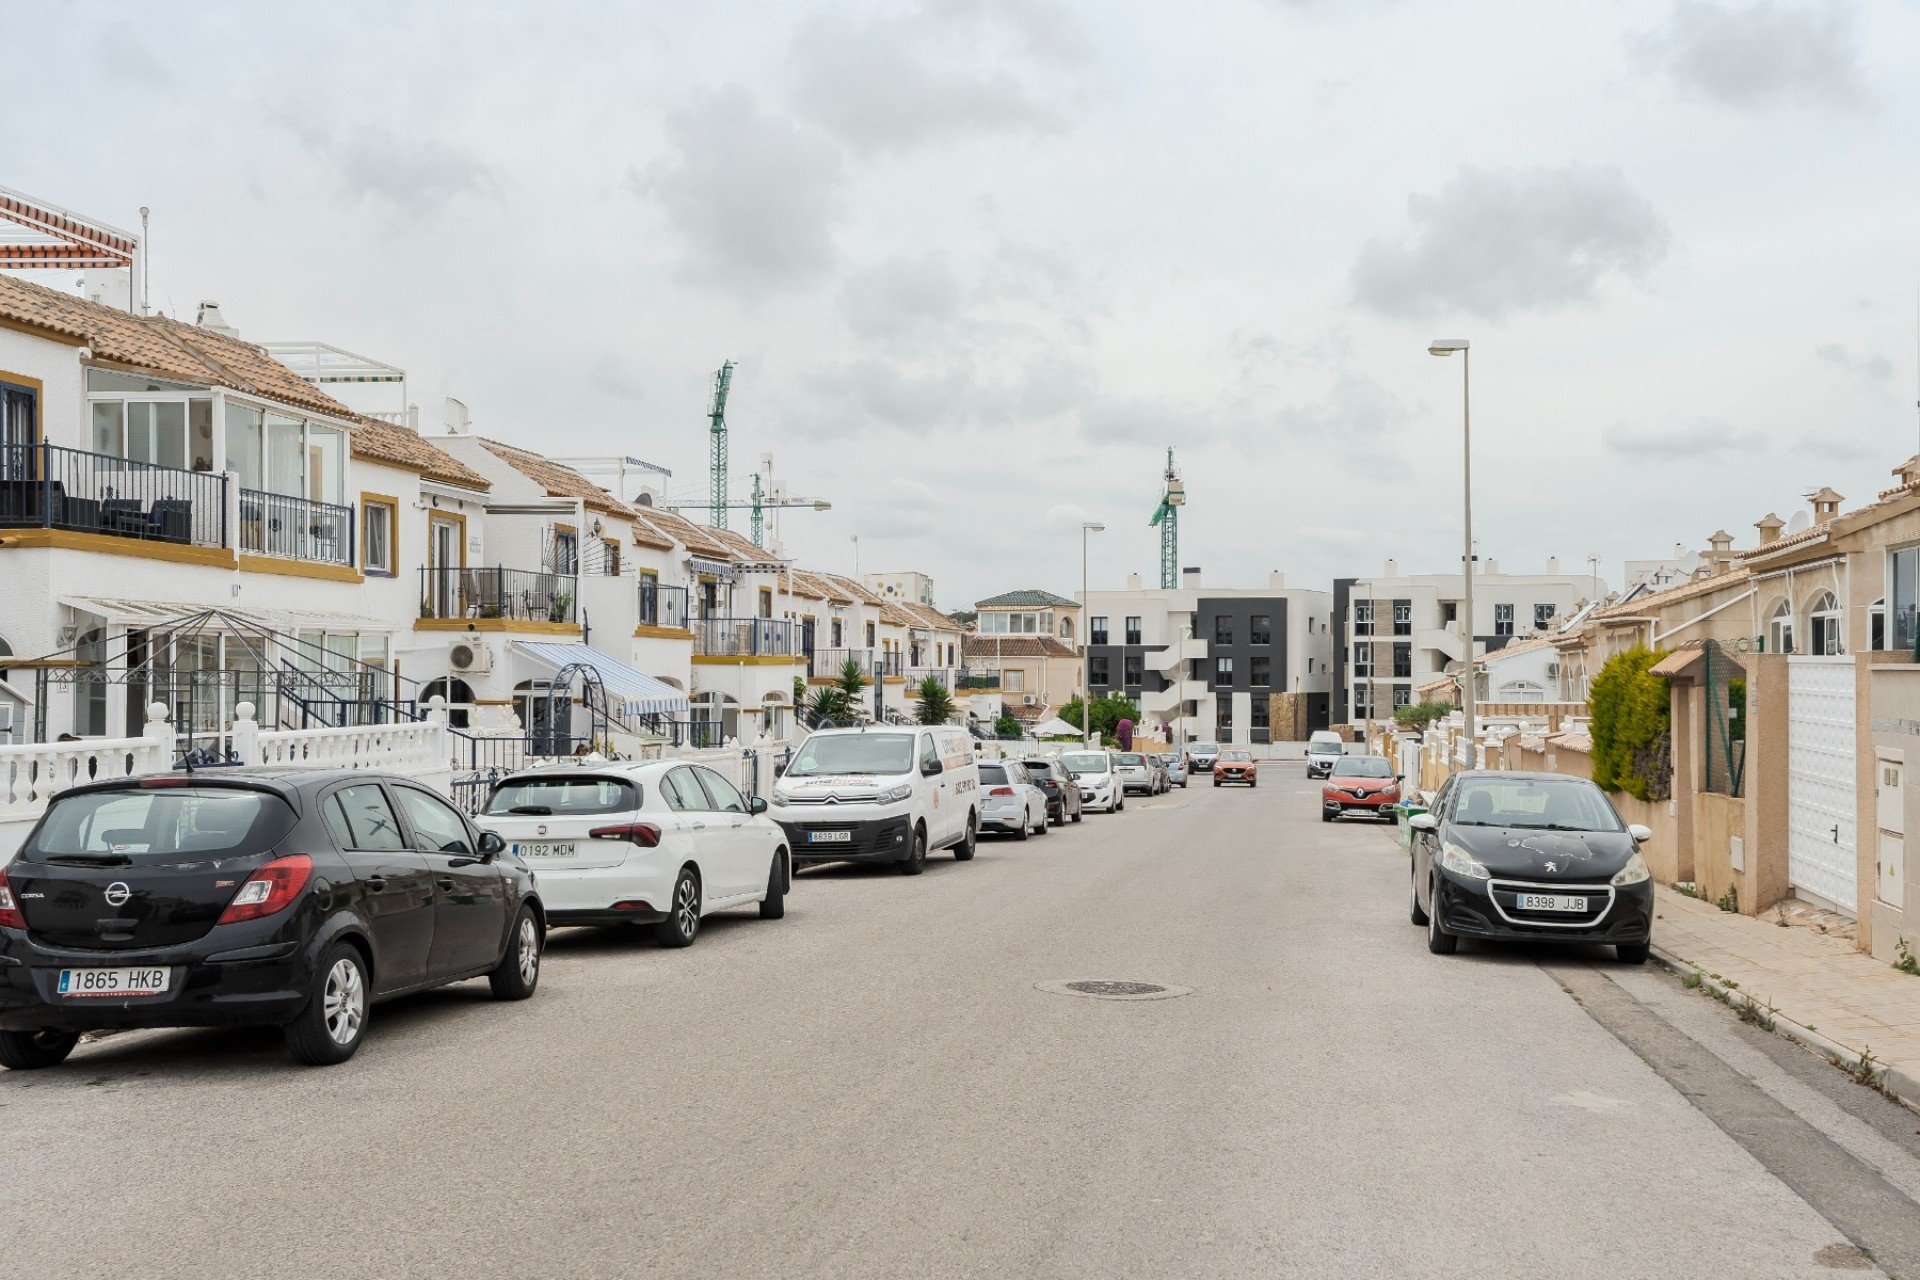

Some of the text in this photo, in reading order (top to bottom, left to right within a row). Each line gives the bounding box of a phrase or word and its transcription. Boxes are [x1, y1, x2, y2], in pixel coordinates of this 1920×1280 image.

[520, 844, 575, 857] 0192 MDM
[1526, 896, 1584, 910] 8398 JJB
[75, 970, 164, 990] 1865 HKB
